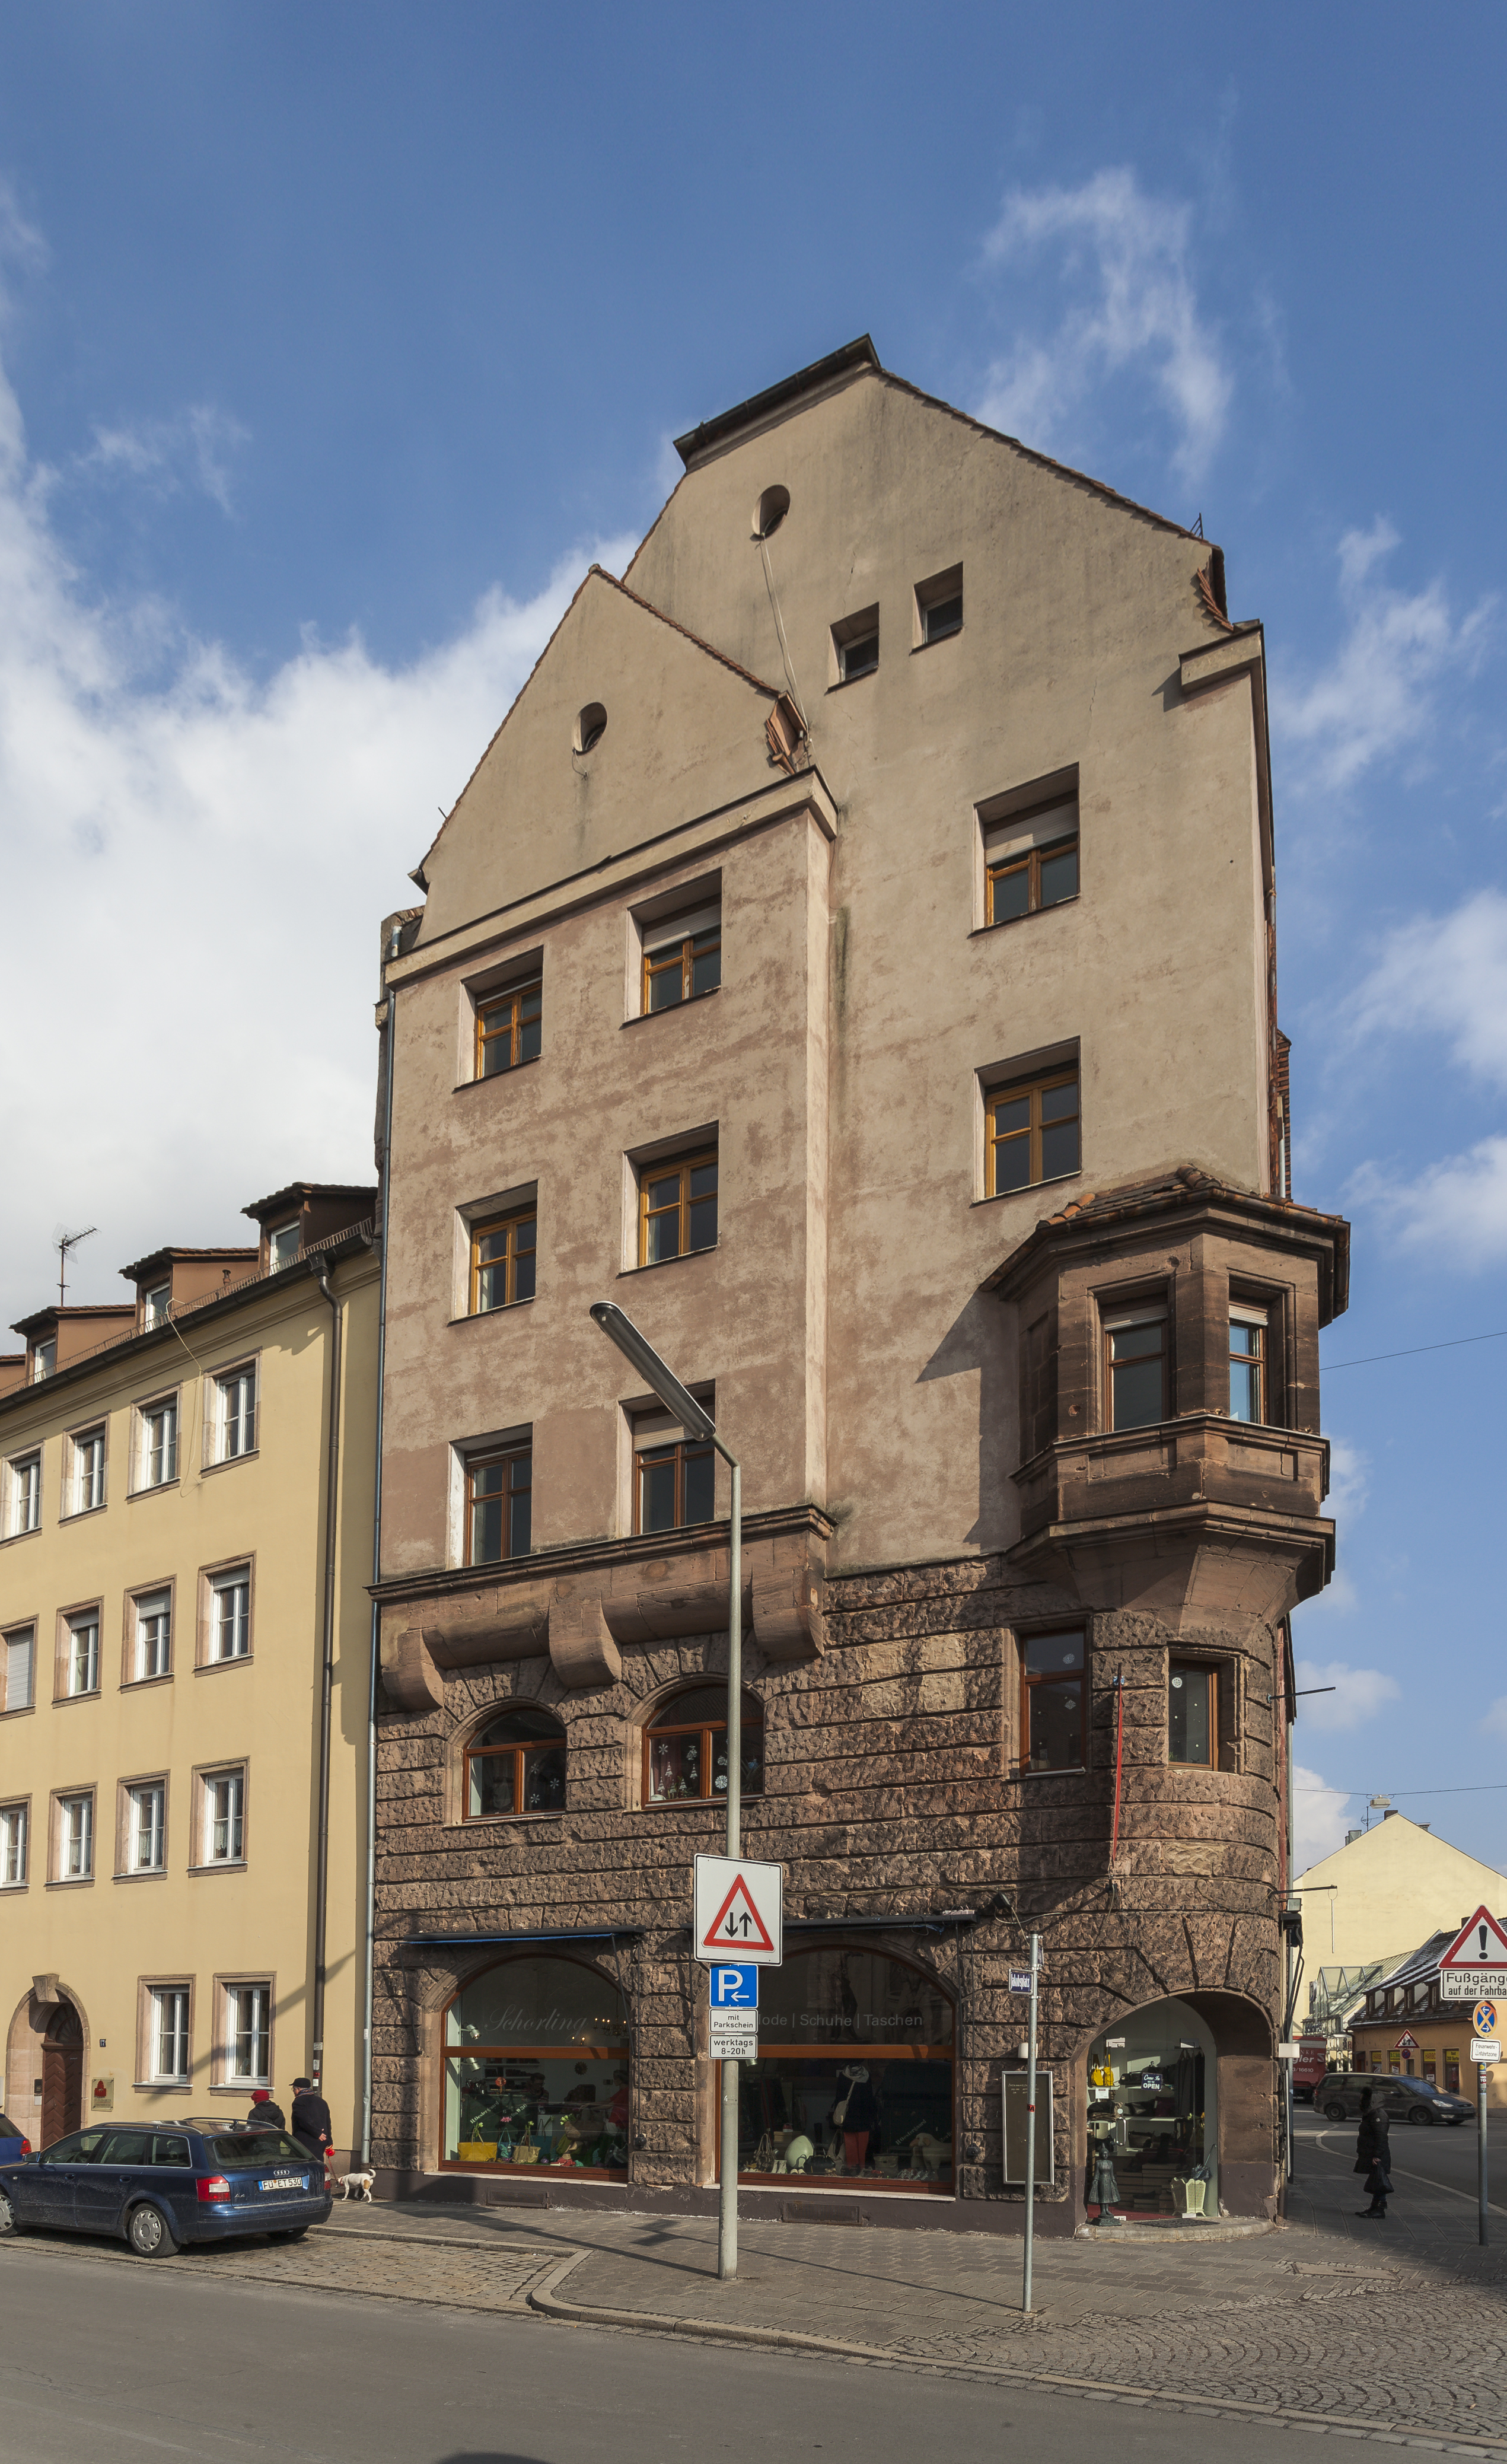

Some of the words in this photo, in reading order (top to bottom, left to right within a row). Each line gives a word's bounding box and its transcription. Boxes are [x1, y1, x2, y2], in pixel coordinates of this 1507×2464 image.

[719, 1970, 743, 2001] P
[1011, 1973, 1030, 1990] Jakobsplatz
[1447, 1972, 1507, 1986] Fußgäng
[1448, 1985, 1461, 1995] auf
[1464, 1985, 1477, 1995] der
[484, 2004, 589, 2043] Schorling
[758, 2014, 787, 2026] ode
[800, 2014, 852, 2027] Schuhe
[864, 2014, 922, 2026] Taschen
[713, 2039, 753, 2048] werktags
[1292, 2054, 1314, 2064] gler
[263, 2180, 273, 2189] FÜ
[278, 2179, 287, 2188] ET
[289, 2178, 302, 2186] 530
